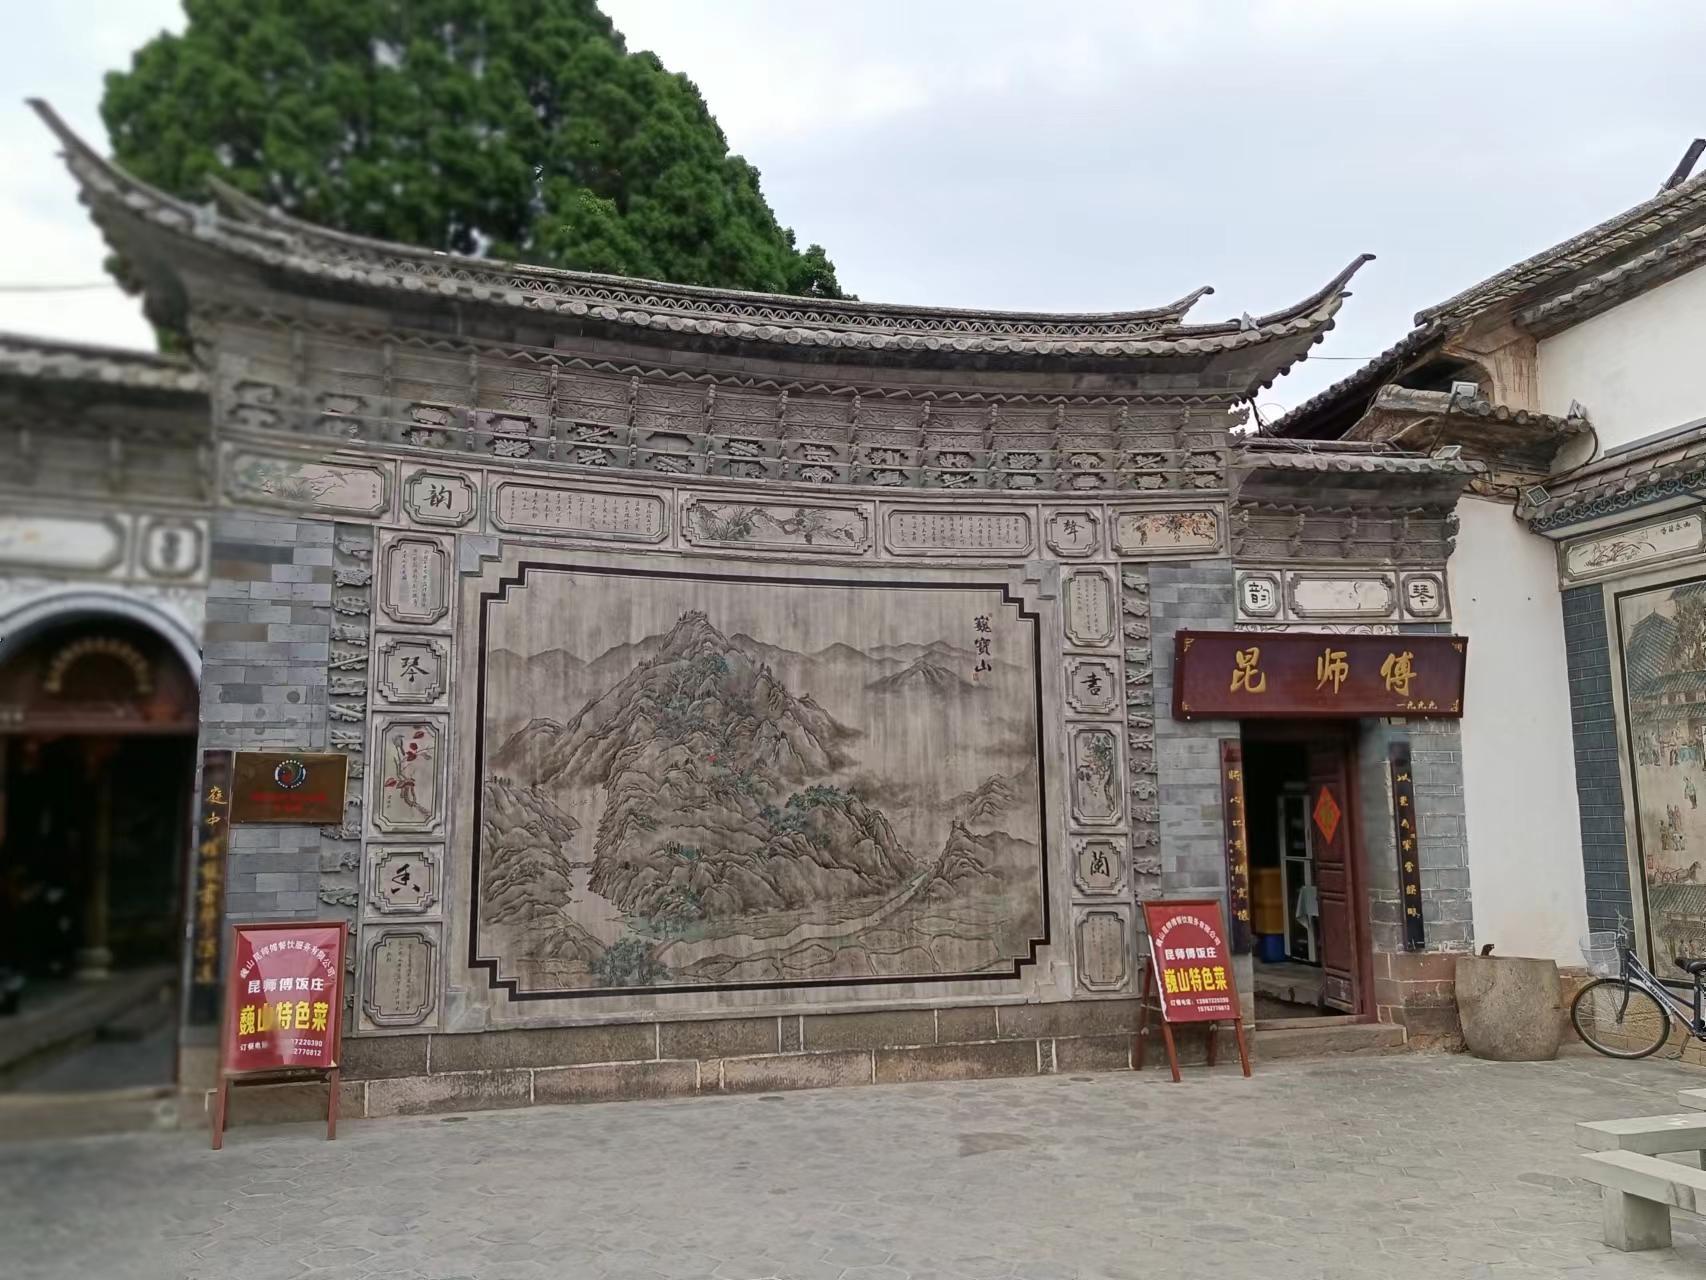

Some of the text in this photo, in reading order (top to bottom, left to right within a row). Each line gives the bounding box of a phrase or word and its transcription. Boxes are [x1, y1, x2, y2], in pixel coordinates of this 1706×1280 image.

[1409, 585, 1434, 606] 琴
[1230, 646, 1417, 696] 昆师傅
[1164, 946, 1217, 960] 昆师傅饭庄
[248, 978, 325, 994] 昆师傅饭庄
[1164, 966, 1228, 993] 巍山特色菜
[239, 1001, 329, 1036] 巍山特色菜
